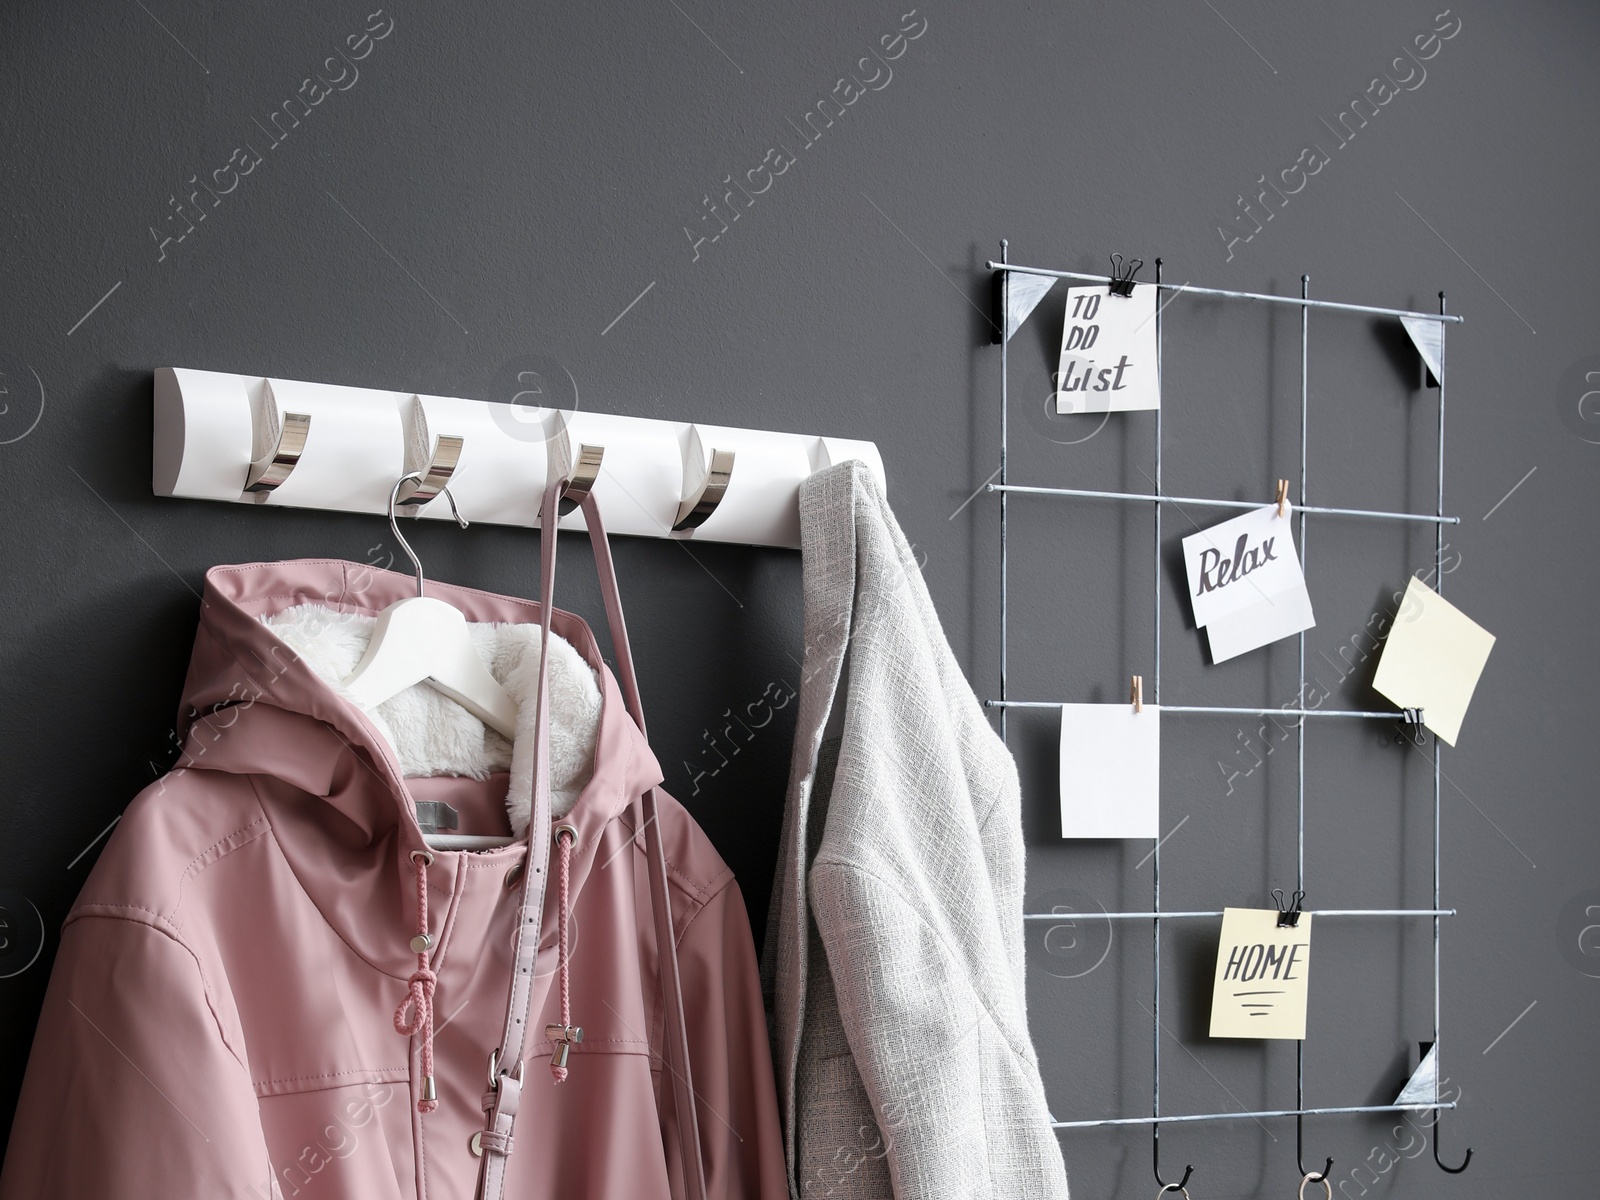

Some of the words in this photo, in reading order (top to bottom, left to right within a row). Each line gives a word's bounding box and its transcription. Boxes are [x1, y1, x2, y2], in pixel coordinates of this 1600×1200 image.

[1072, 294, 1101, 320] TO
[1065, 325, 1099, 351] DO
[1061, 355, 1134, 392] List
[1196, 533, 1278, 596] Relax
[1223, 944, 1309, 982] HOME
